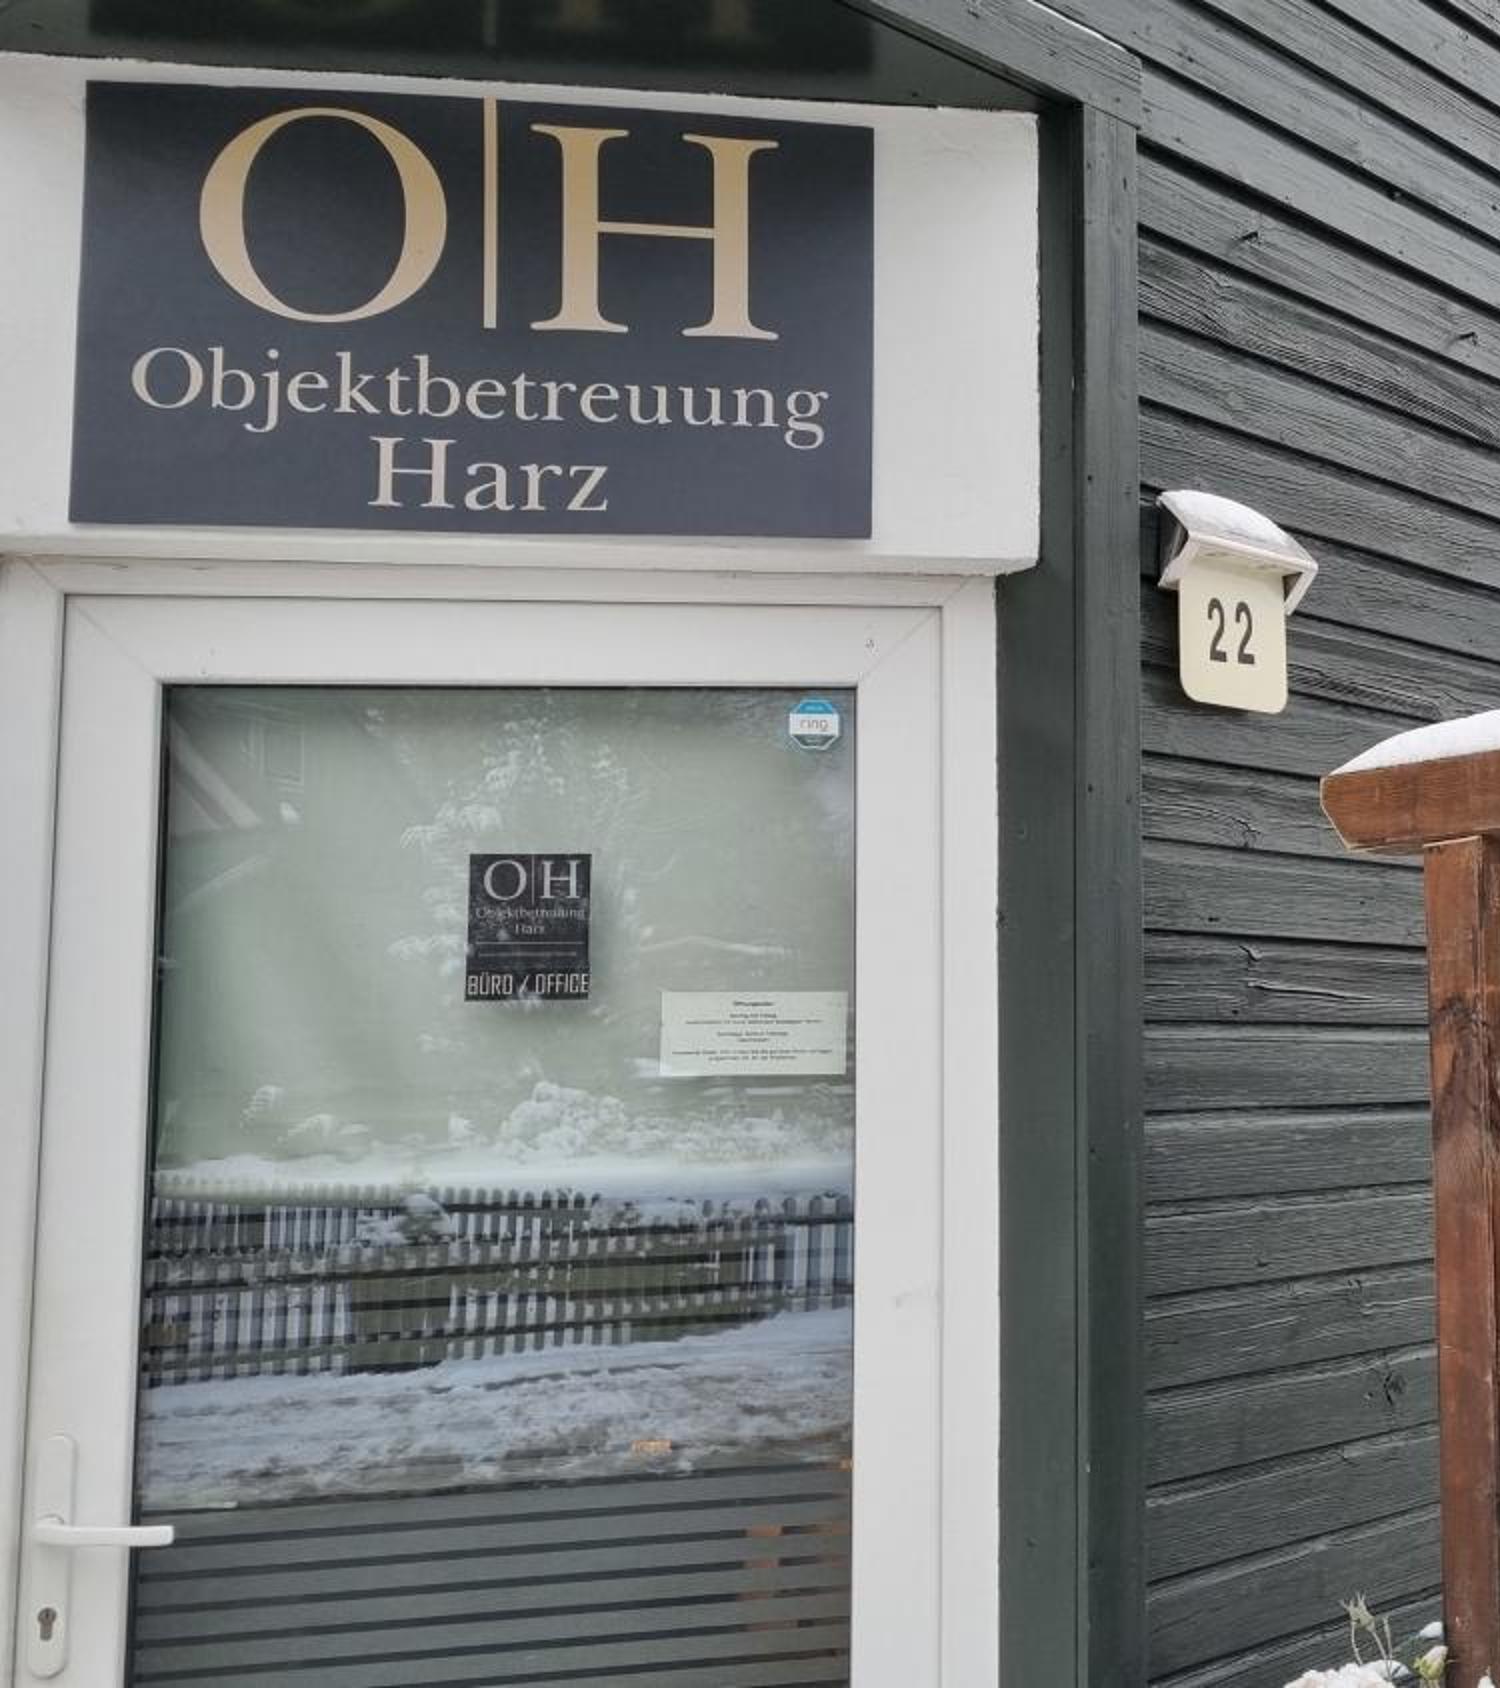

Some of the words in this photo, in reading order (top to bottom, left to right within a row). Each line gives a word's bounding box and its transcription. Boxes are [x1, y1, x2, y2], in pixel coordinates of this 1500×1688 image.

[130, 346, 829, 449] Objektbetreuung
[367, 437, 609, 513] Harz
[1207, 597, 1255, 665] 22
[468, 972, 513, 995] BÜRO
[535, 972, 590, 993] OFFICE
